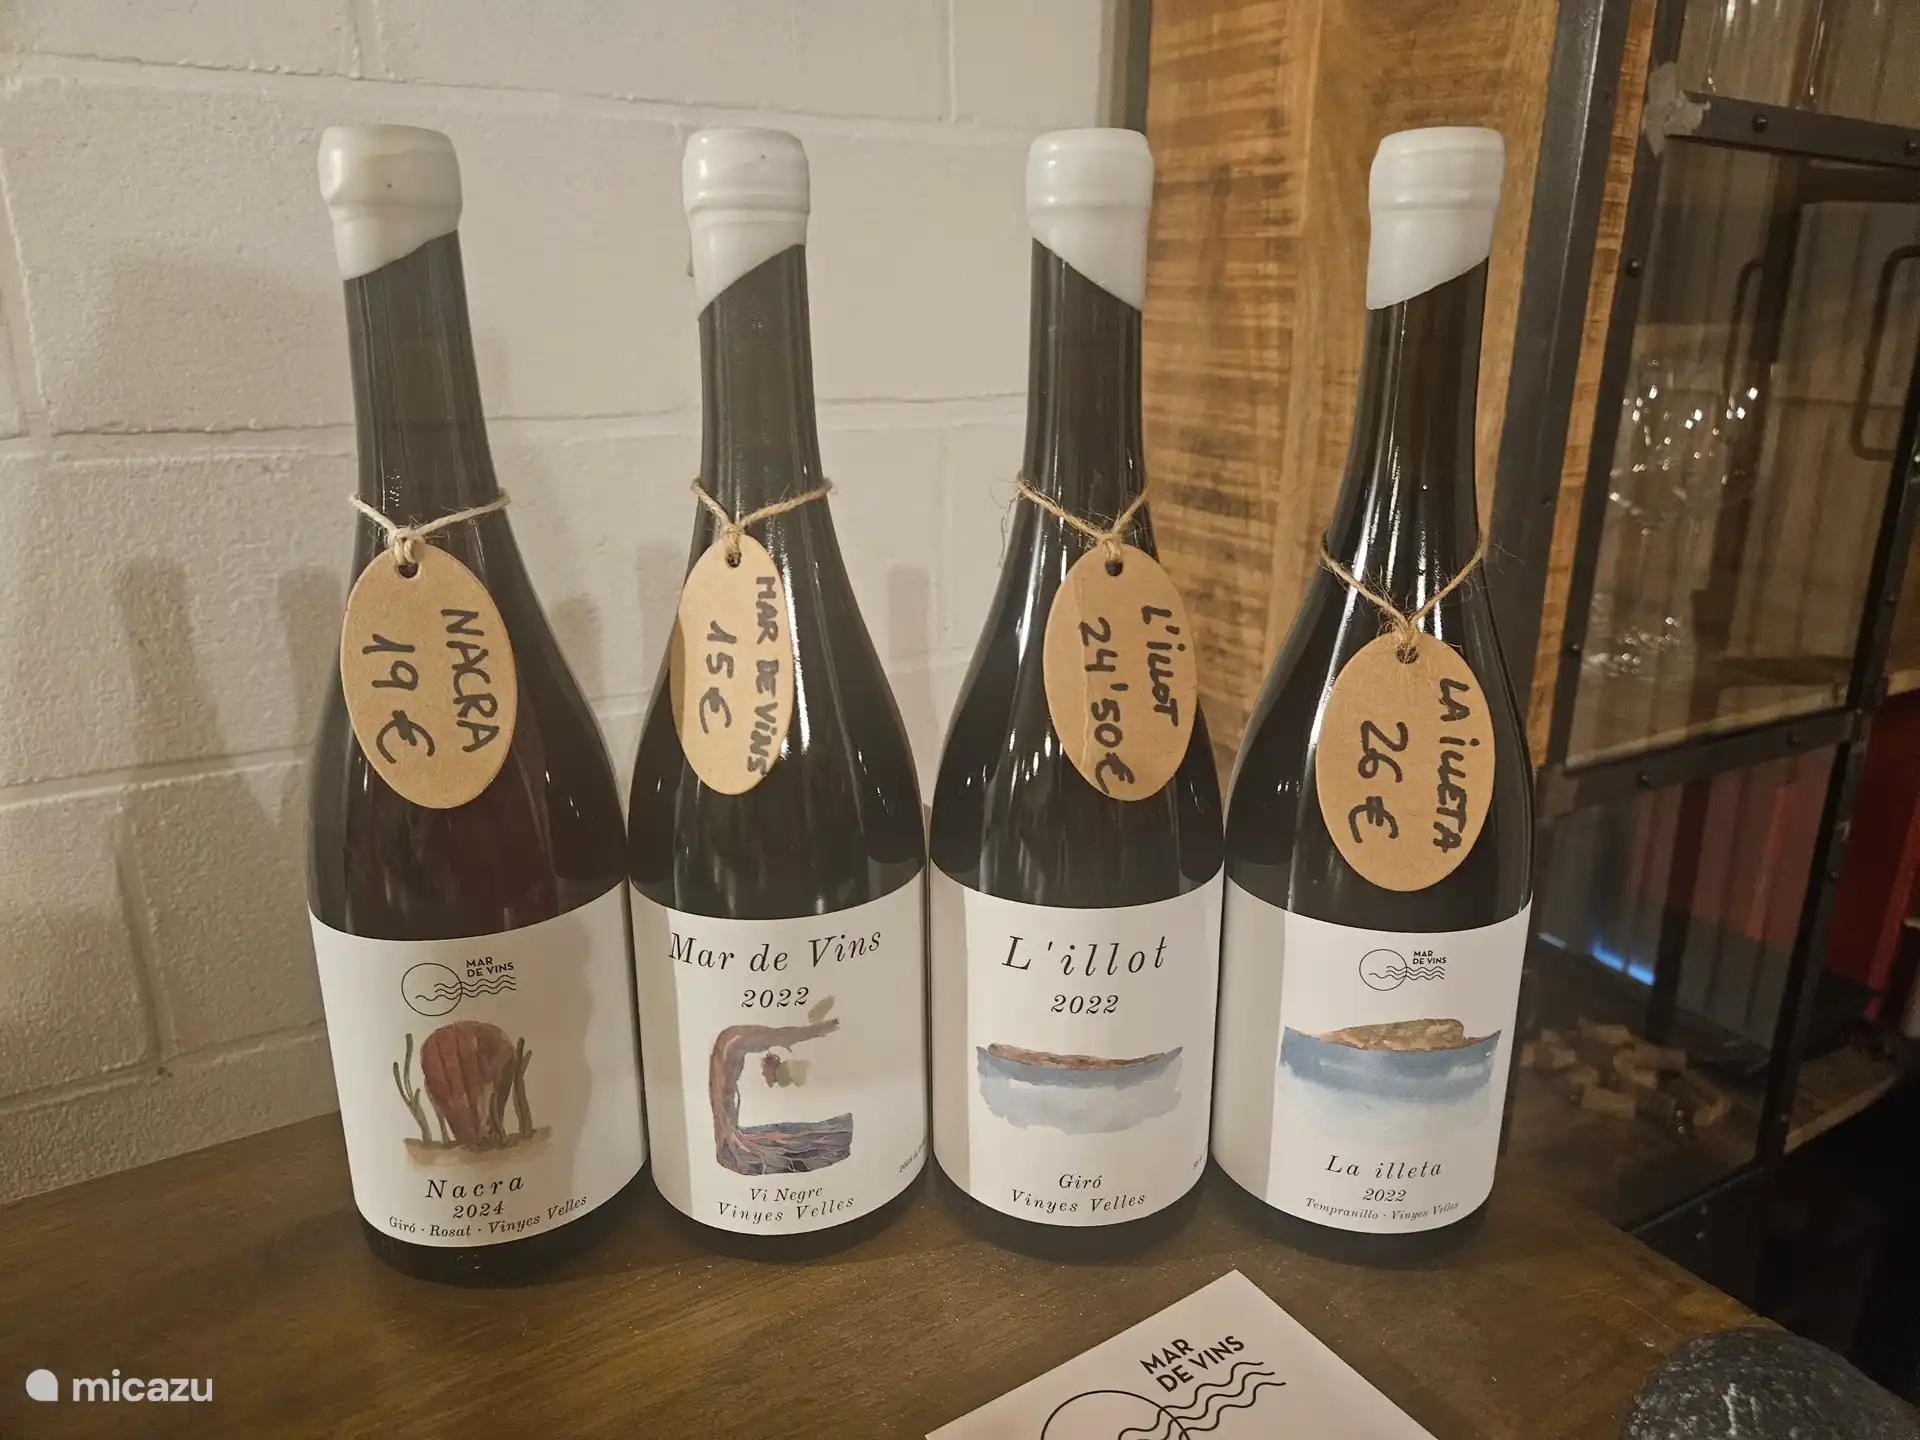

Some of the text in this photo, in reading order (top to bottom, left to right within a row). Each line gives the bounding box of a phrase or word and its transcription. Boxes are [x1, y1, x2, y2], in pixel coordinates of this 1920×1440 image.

[440, 609, 500, 753] NACRA
[755, 658, 780, 698] DE
[1439, 678, 1471, 722] LA
[466, 956, 493, 968] MAR
[668, 931, 881, 972] Mar de Vins
[1001, 935, 1167, 976] L'illot
[1413, 950, 1434, 958] MAR
[1413, 956, 1447, 965] DE VINS
[467, 962, 515, 978] DE VINS
[741, 987, 810, 1008] 2022
[1051, 994, 1119, 1014] 2022
[1325, 1154, 1443, 1179] La illeta
[425, 1176, 524, 1199] Nacra
[1059, 1173, 1103, 1189] Giró
[750, 1186, 823, 1204] Vi Negre
[1012, 1189, 1146, 1214] Vinyes Velles
[1363, 1188, 1407, 1202] 2022
[389, 1194, 587, 1237] Giró Rosat Vinyes Velles
[452, 1201, 504, 1219] 2024
[718, 1198, 854, 1225] Vinyes Velles
[1305, 1197, 1459, 1221] Tempranillo Vinyes Velles
[1139, 1338, 1195, 1375] MAR
[1155, 1335, 1245, 1393] DE VINS
